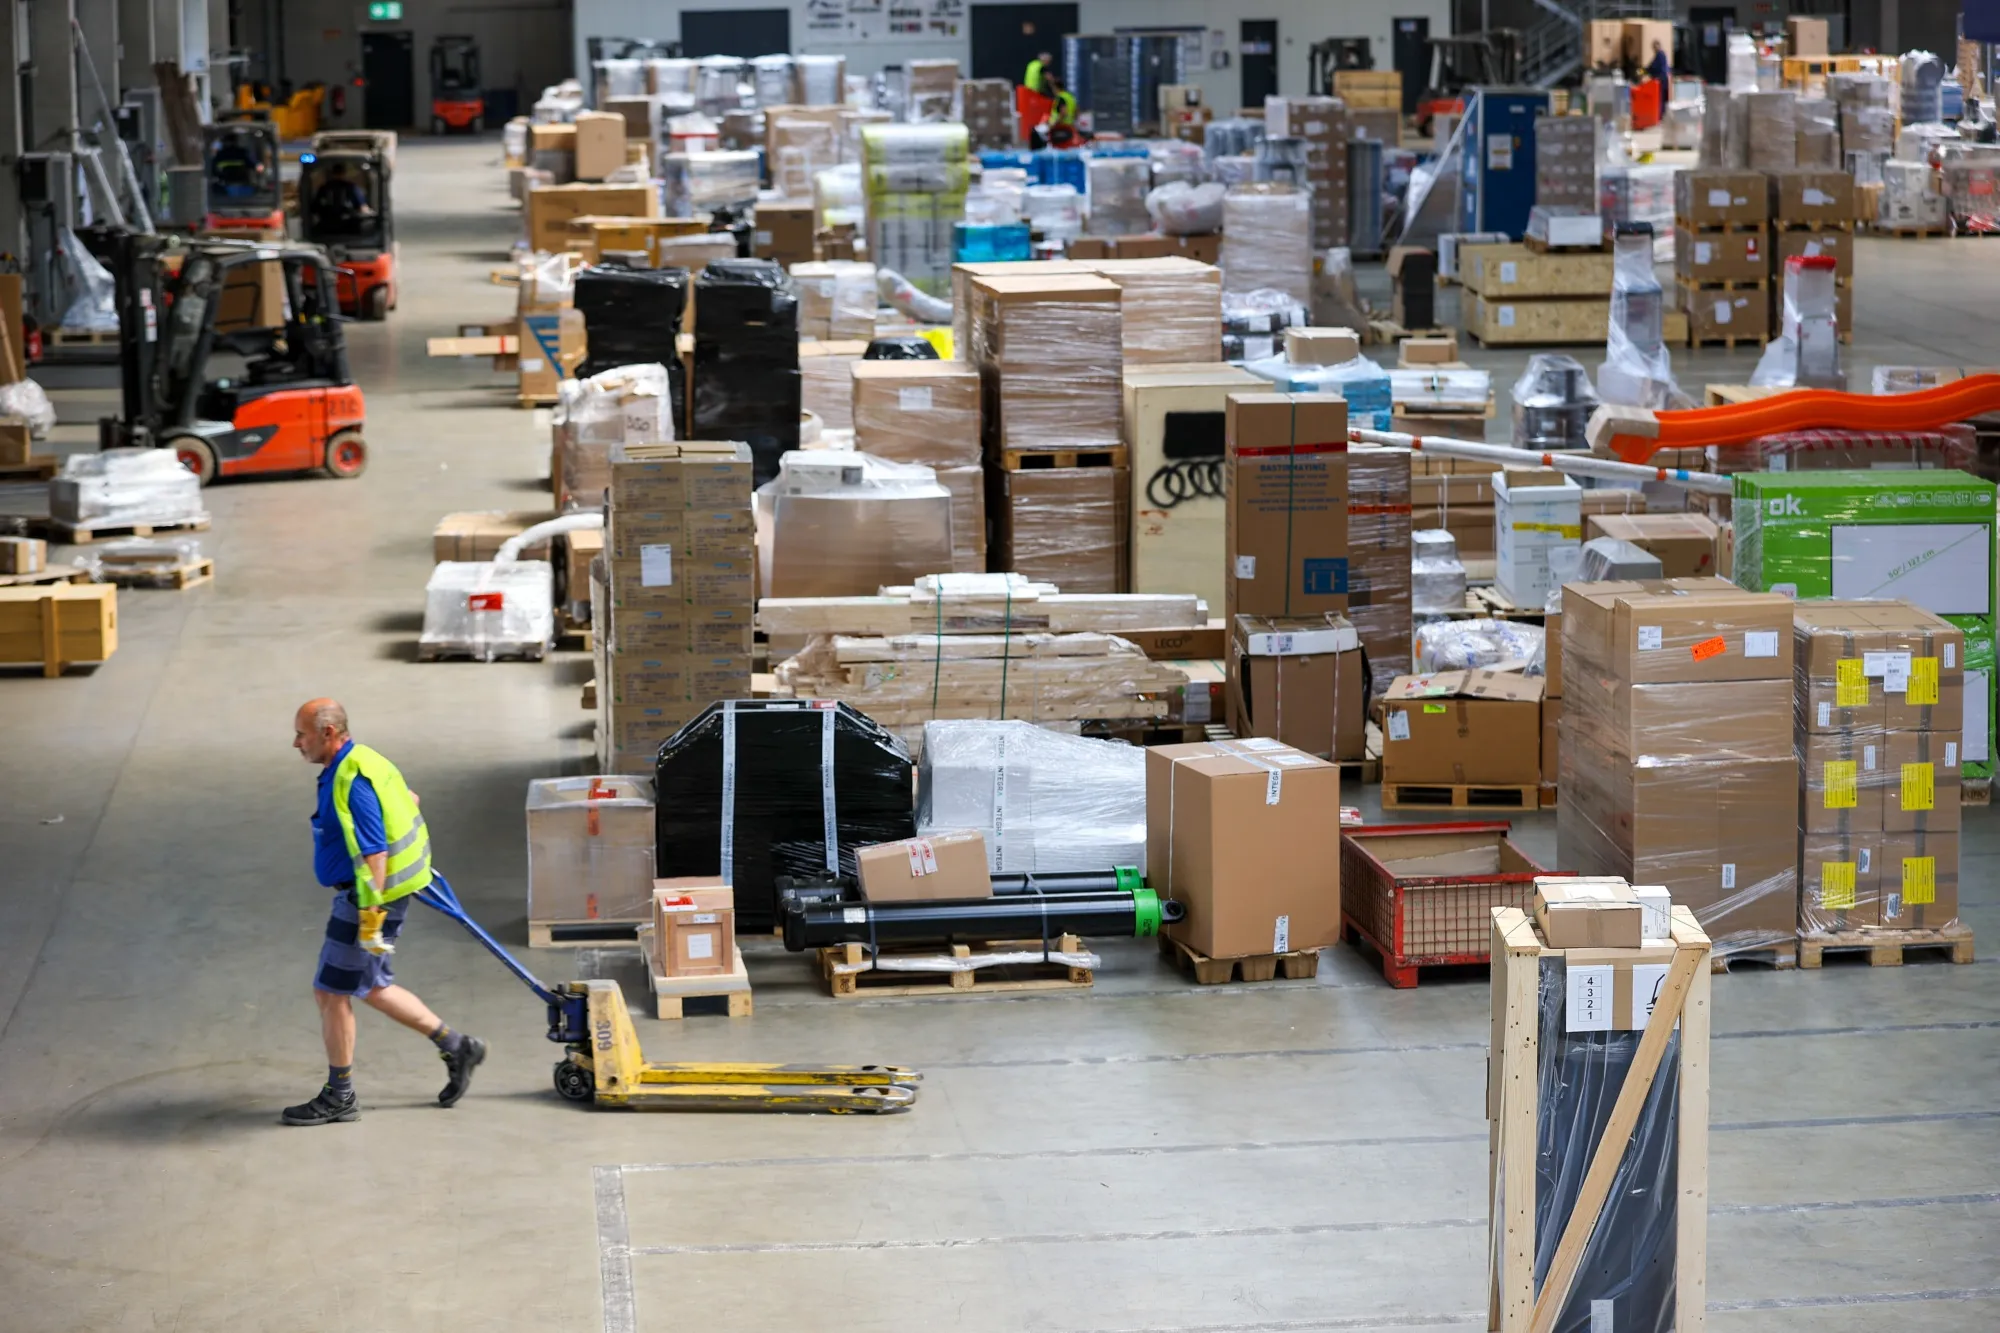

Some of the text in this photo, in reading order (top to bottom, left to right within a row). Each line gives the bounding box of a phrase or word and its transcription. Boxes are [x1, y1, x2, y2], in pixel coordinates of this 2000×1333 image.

[1154, 638, 1183, 649] LECO
[1587, 977, 1593, 985] 4
[1587, 988, 1593, 997] 3
[1587, 1000, 1593, 1008] 2
[1588, 1011, 1593, 1019] 1
